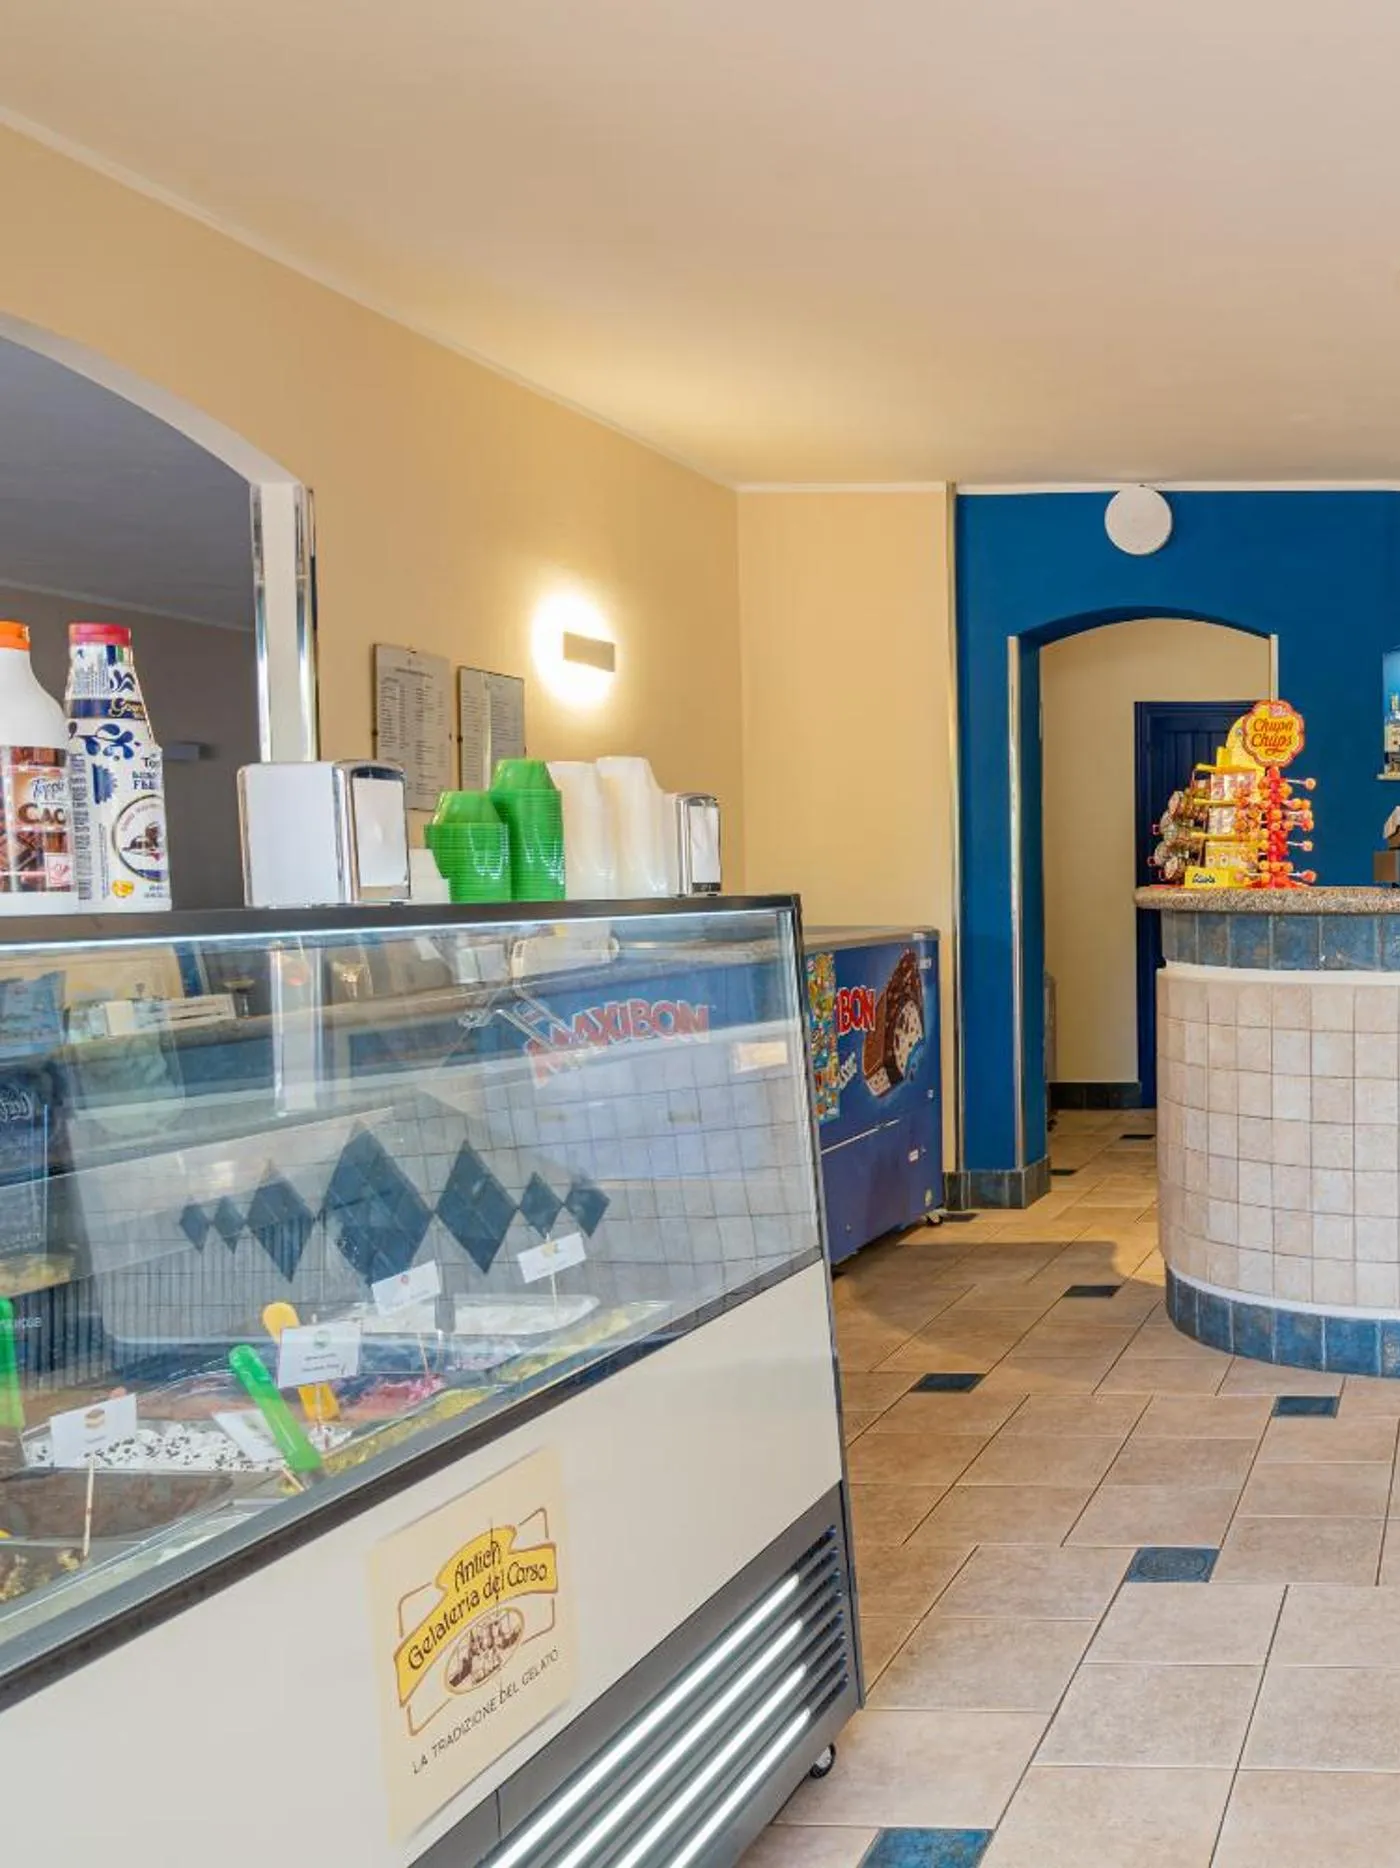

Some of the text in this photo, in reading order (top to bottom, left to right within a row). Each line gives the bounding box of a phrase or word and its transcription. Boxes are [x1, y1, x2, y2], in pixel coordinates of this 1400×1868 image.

[1251, 733, 1293, 752] Chups
[1253, 718, 1294, 733] Chupa
[408, 1561, 548, 1671] Gelateria del Corso
[412, 1651, 559, 1775] LA TRADIZIONE DEL GELATO
